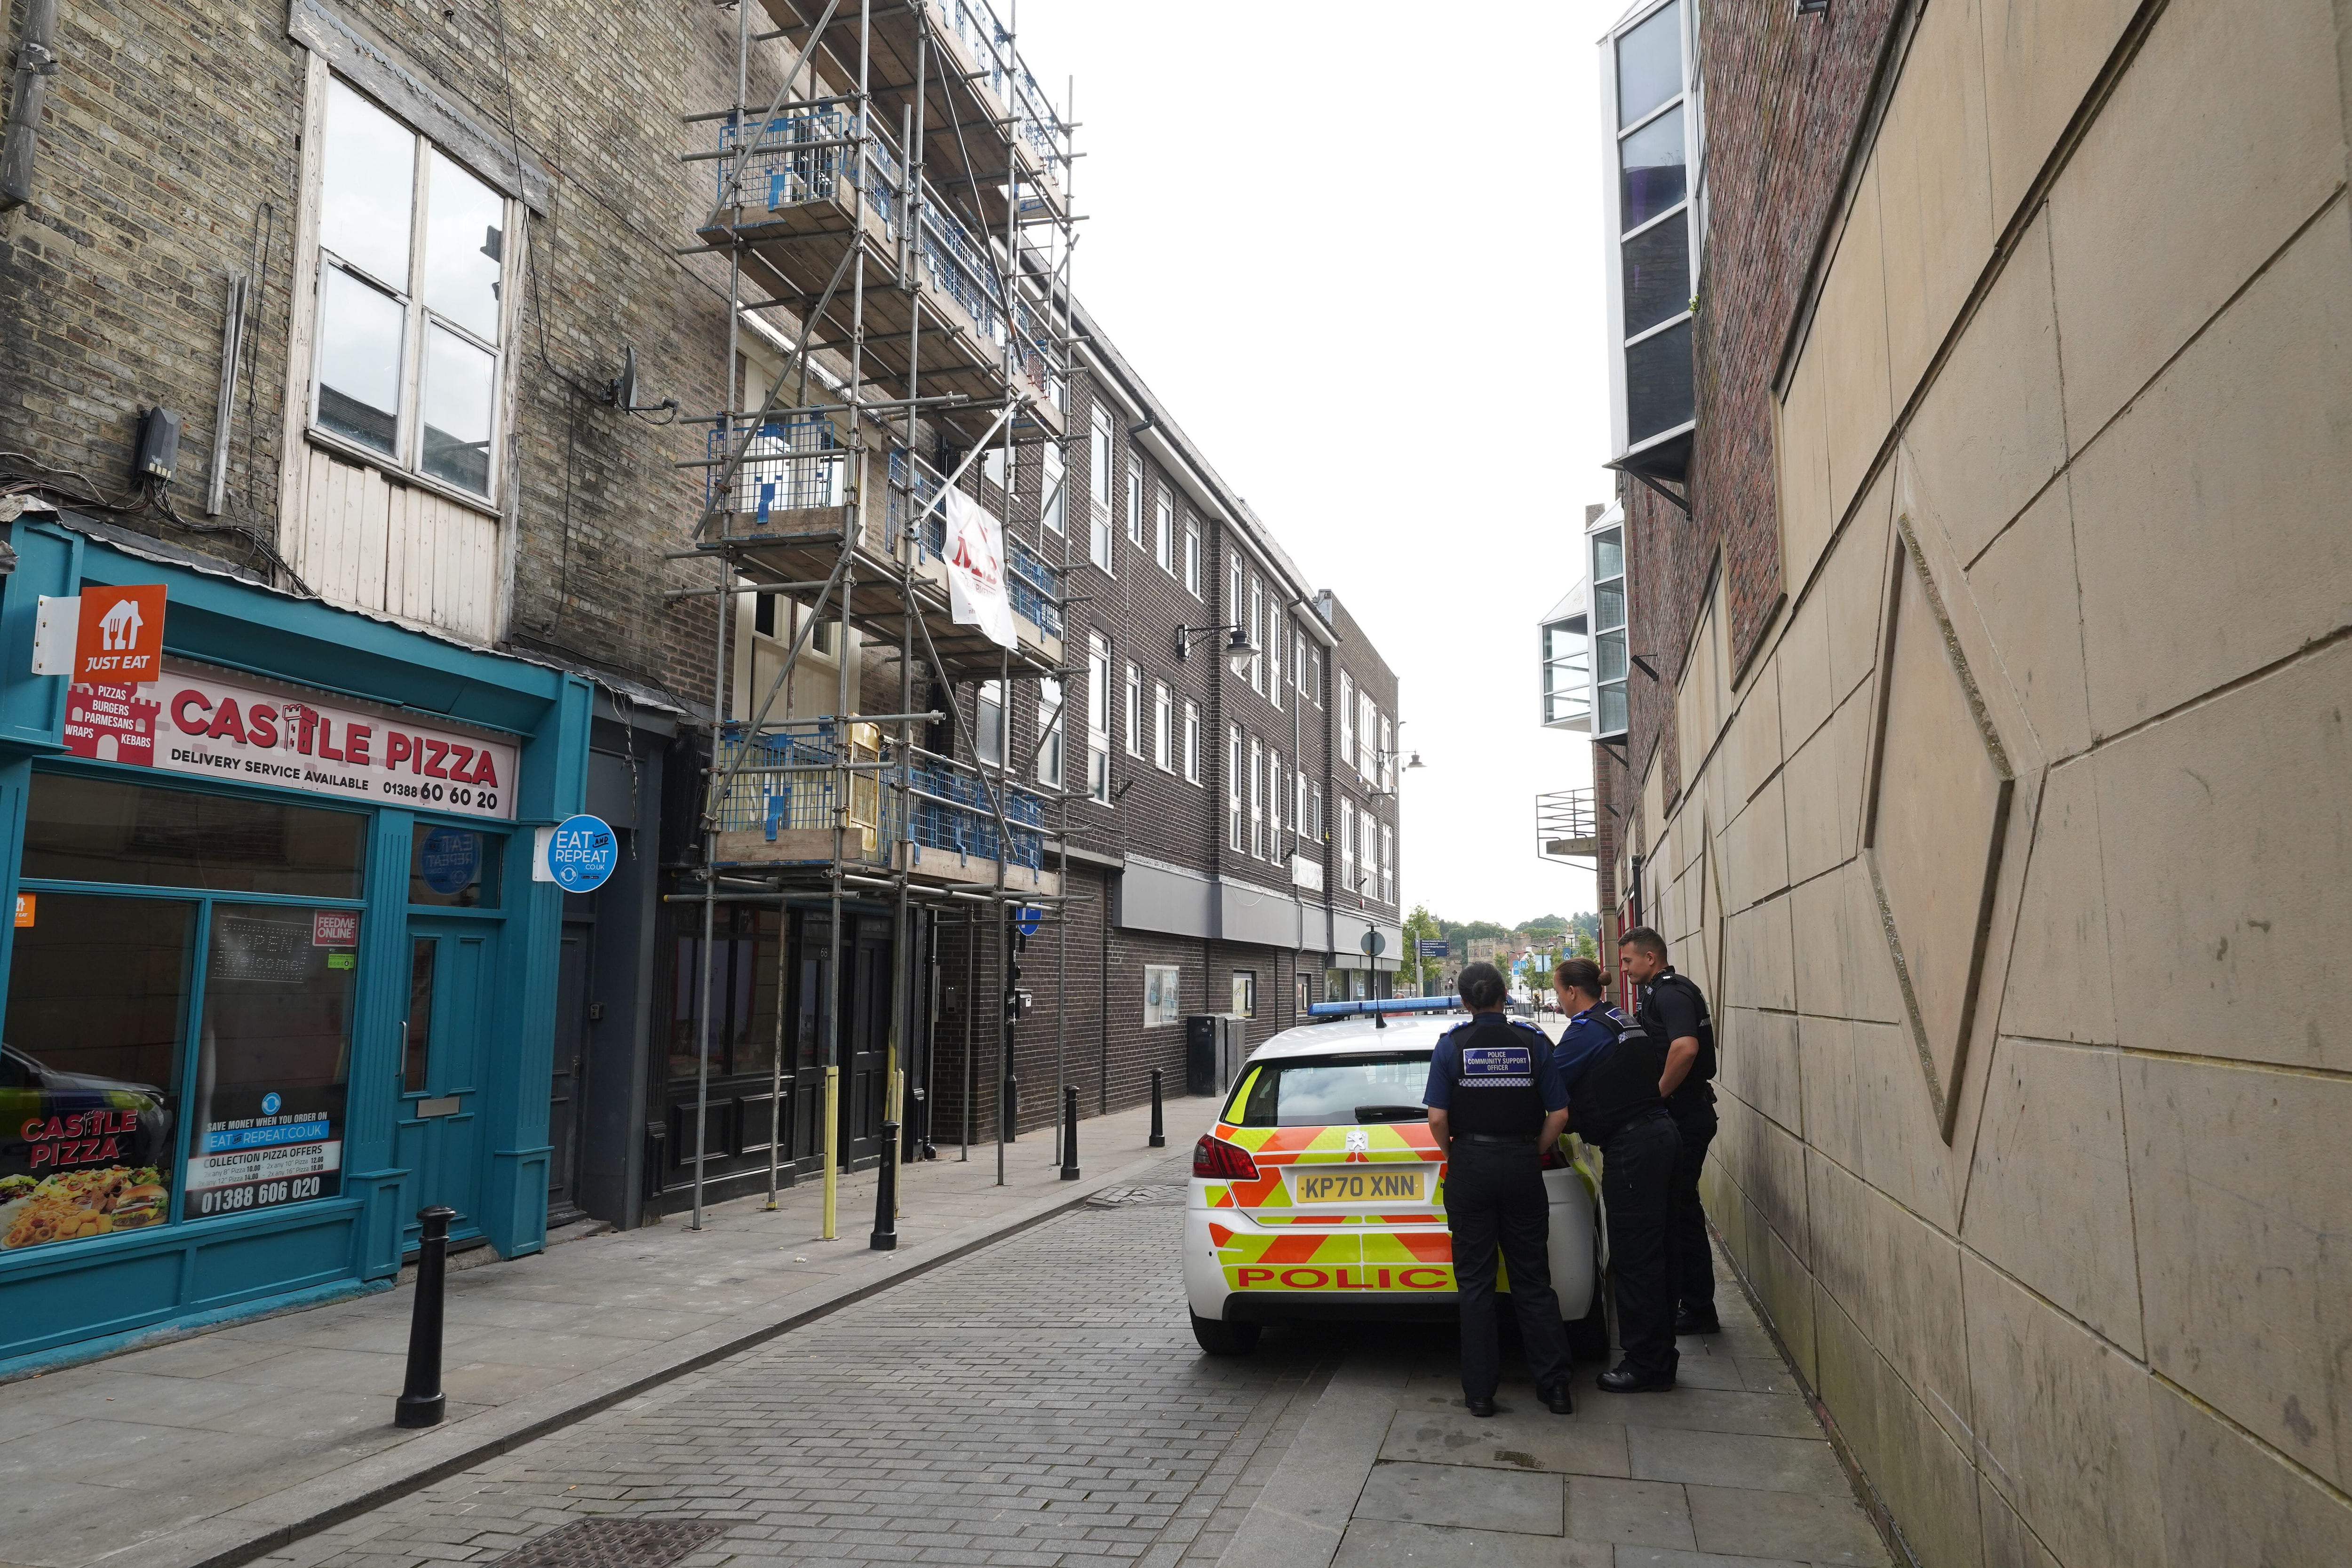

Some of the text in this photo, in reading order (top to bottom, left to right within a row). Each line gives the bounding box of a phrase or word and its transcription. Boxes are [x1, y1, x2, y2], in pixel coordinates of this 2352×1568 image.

[85, 655, 150, 672] JUST EAT
[98, 685, 127, 700] PIZZAS
[92, 700, 129, 716] BURGERS
[84, 712, 134, 730] PARMESANS
[65, 724, 94, 738] WRAPS
[121, 733, 151, 748] KEBABS
[386, 731, 498, 788] PIZZA
[171, 748, 369, 790] DELIVERY SERVICE AVAILABLE
[383, 782, 497, 810] 01388 60 60 20
[556, 831, 608, 849] EAT AND
[555, 850, 609, 863] REPEAT
[318, 917, 356, 928] FEEDME
[317, 927, 352, 938] ONLINE
[239, 934, 293, 952] OPEN
[820, 948, 827, 957] 68
[207, 1111, 328, 1132] SAVE MONEY WHEN YOU ORDER ON
[210, 1134, 233, 1148] EAT
[243, 1124, 322, 1144] REPEAT.CO.UK
[30, 1137, 120, 1169] PIZZA
[204, 1145, 323, 1169] COLLECTION PIZZA OFFERS
[201, 1176, 320, 1214] 01388 606 020
[1305, 1176, 1414, 1198] KP70 XNN
[1238, 1268, 1448, 1288] POLIC
